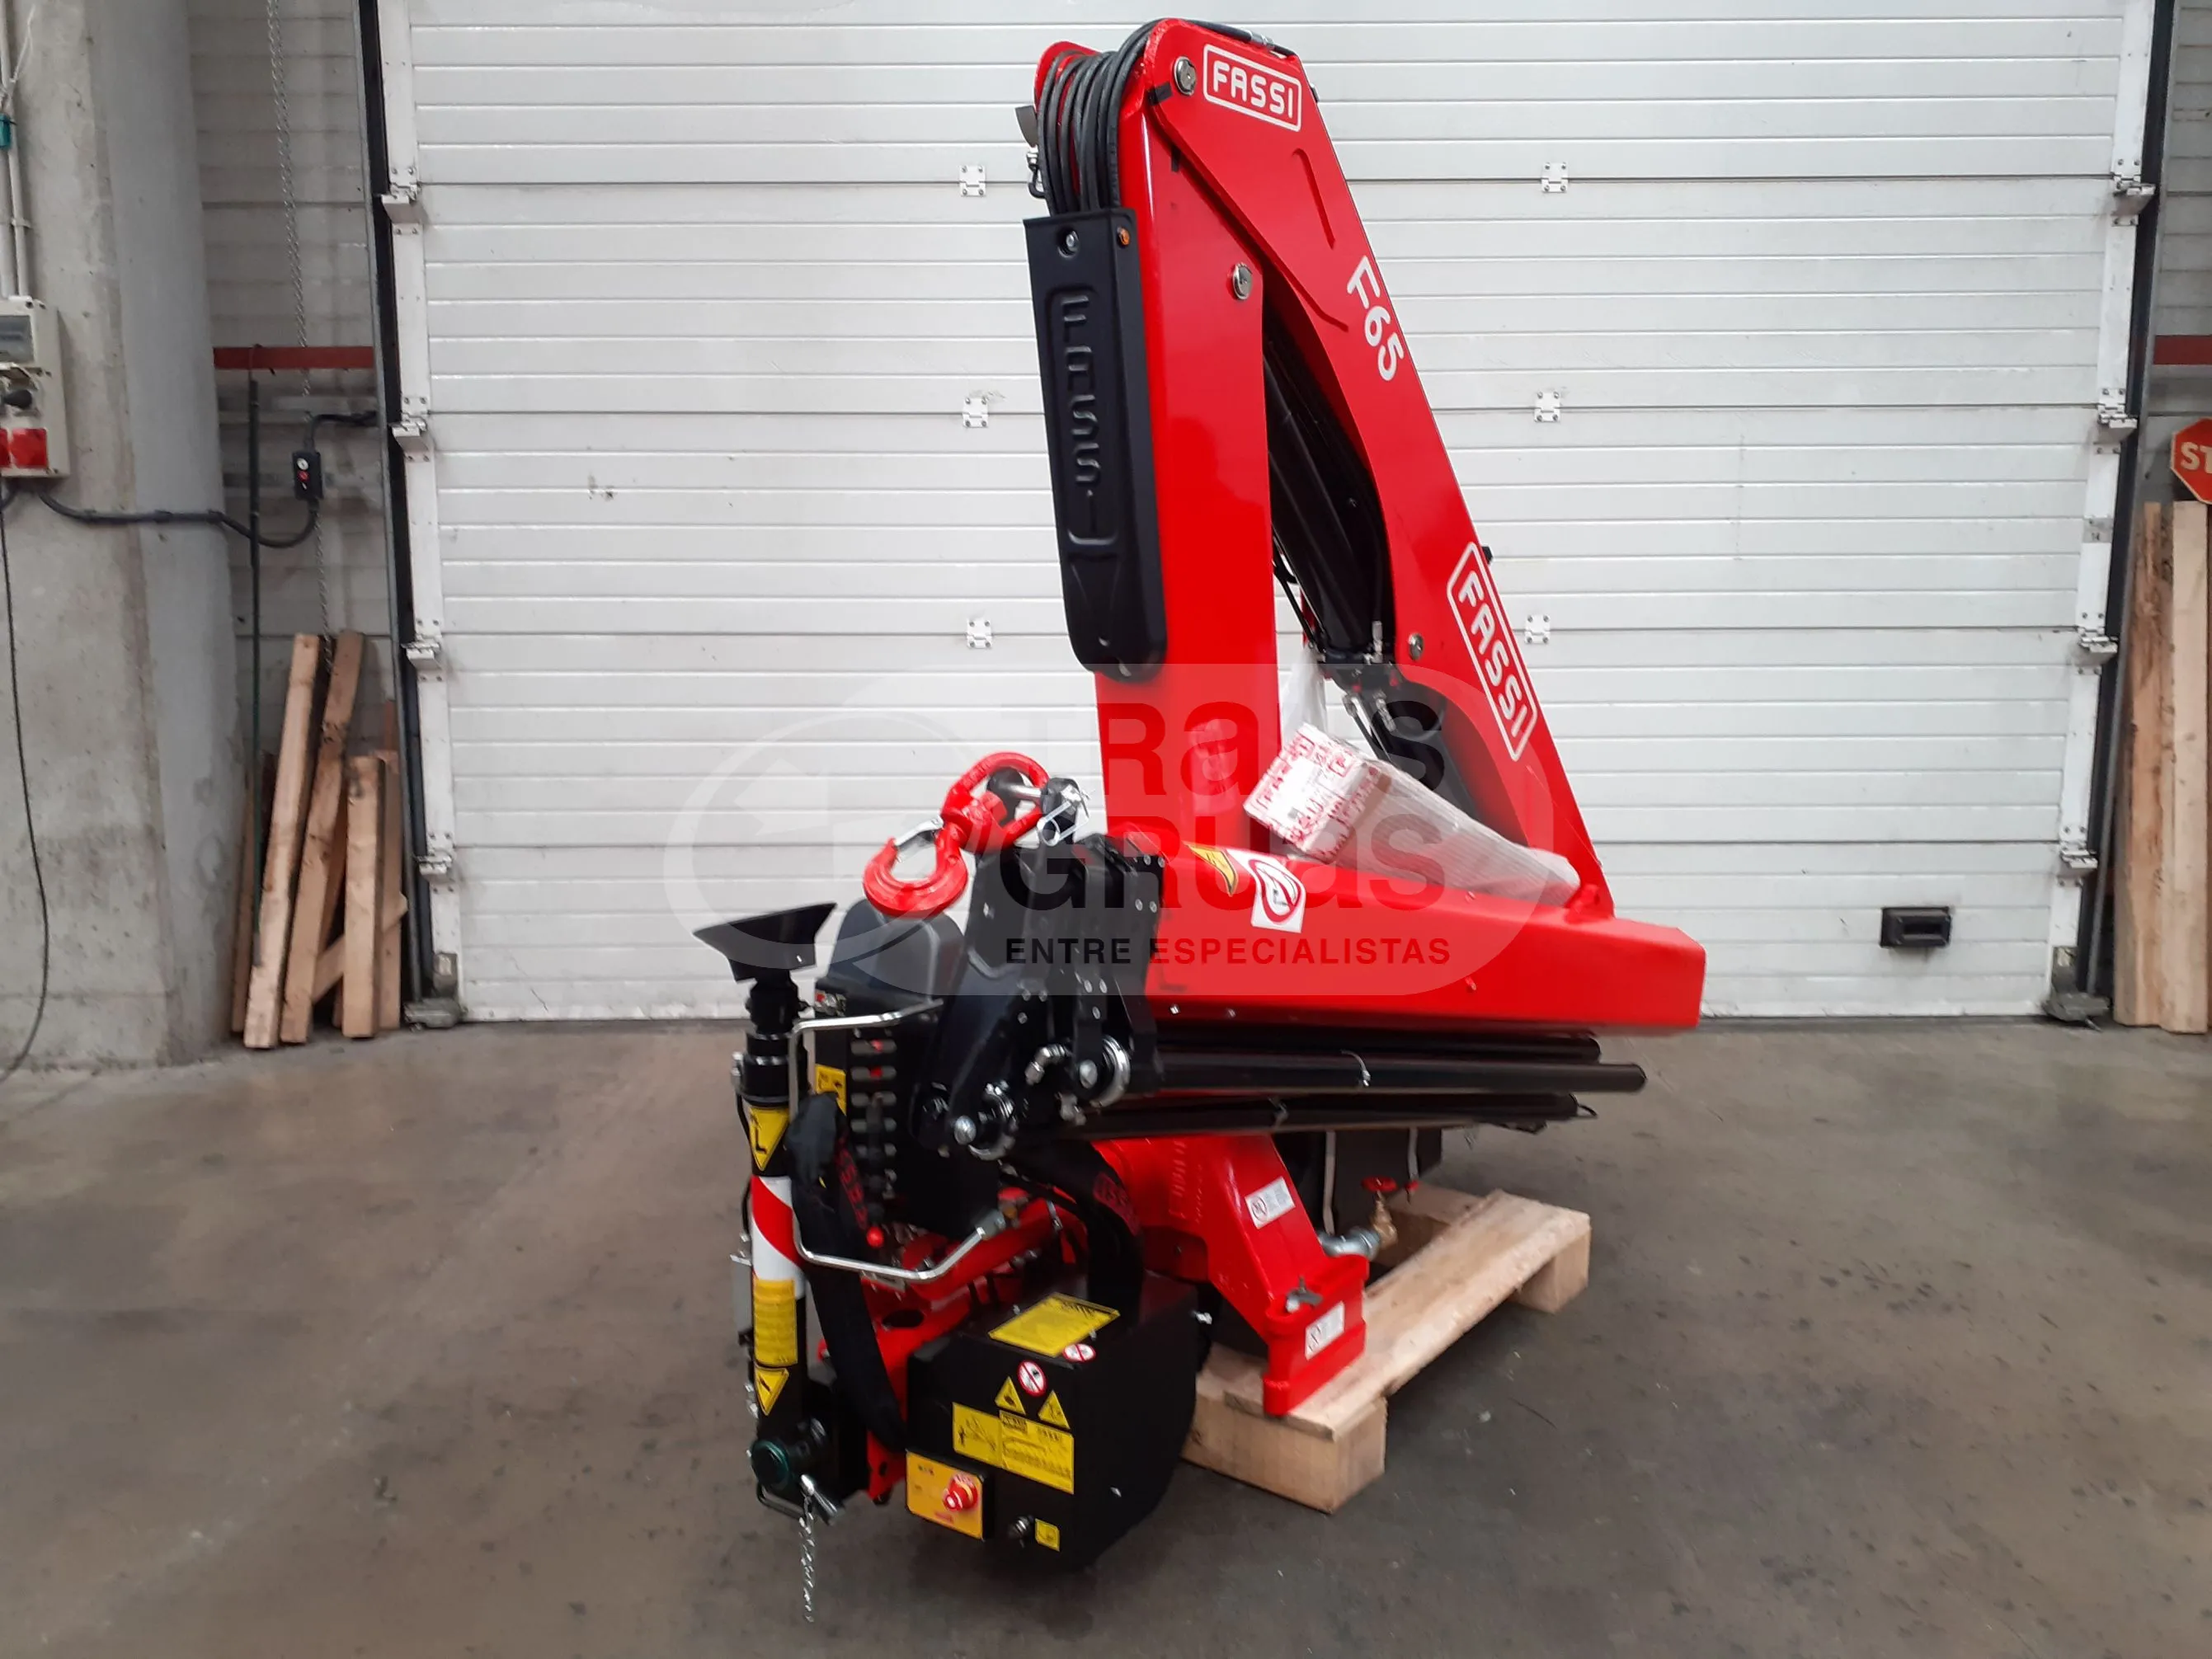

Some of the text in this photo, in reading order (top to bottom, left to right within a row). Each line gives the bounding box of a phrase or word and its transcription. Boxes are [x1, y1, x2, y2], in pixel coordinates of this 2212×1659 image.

[1213, 60, 1293, 119] FASSI
[1347, 255, 1405, 381] F65
[1061, 295, 1101, 533] FASSI
[1458, 571, 1527, 738] FASSI
